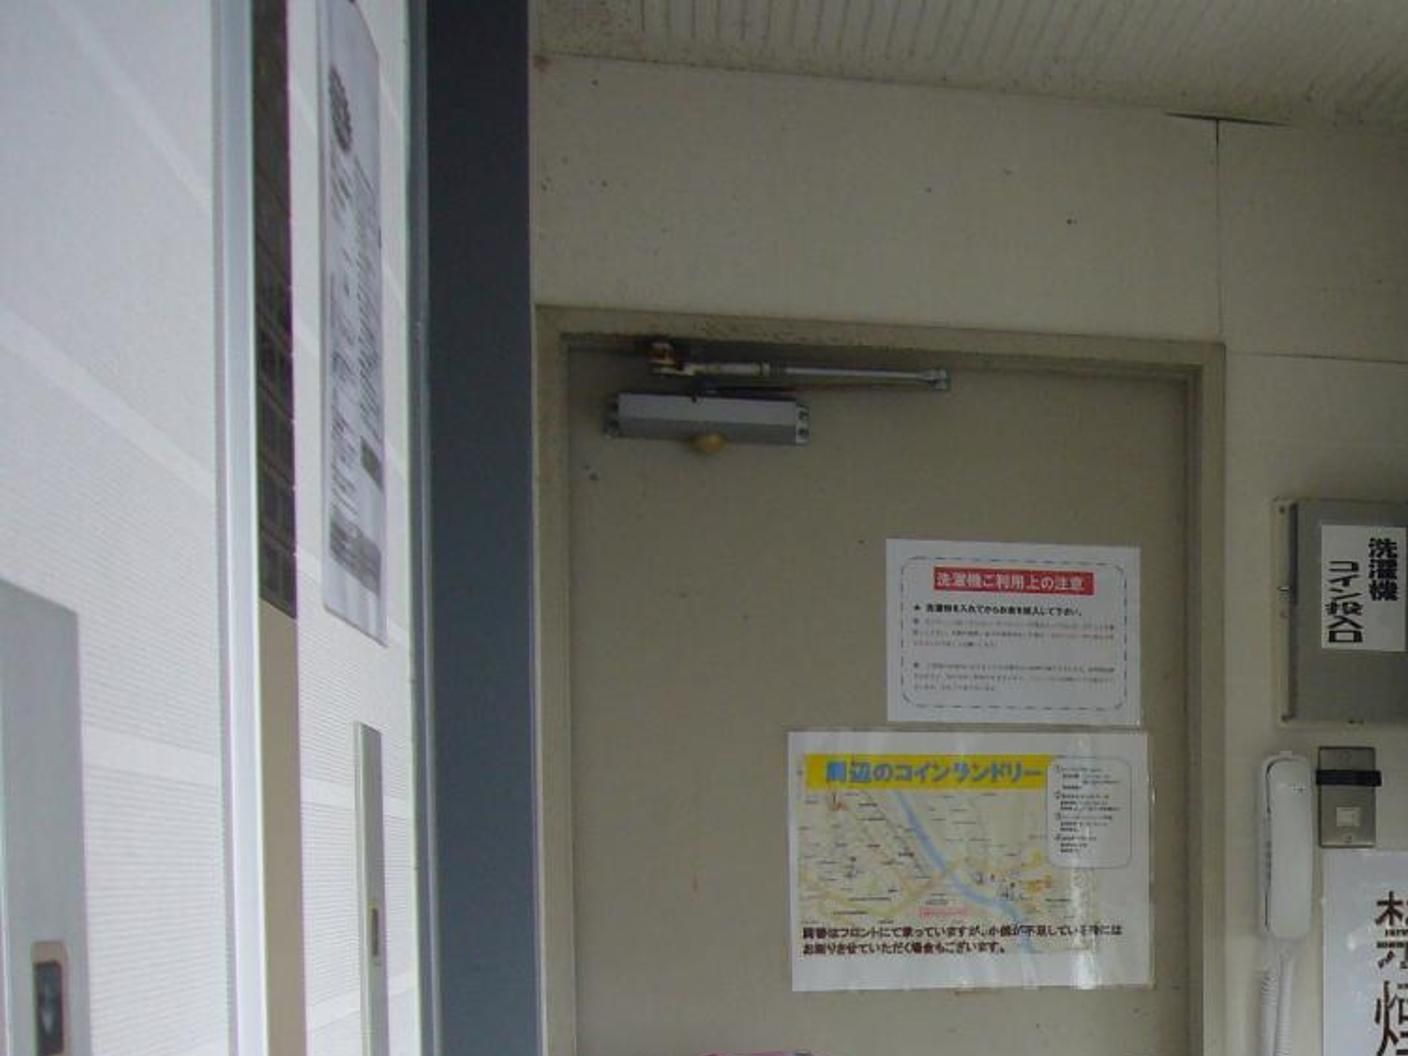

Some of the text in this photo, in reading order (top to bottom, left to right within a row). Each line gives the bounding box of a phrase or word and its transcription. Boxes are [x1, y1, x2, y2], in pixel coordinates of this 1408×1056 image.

[1368, 537, 1398, 602] 洗濯機
[826, 760, 1044, 784] 周辺のコインランドリー
